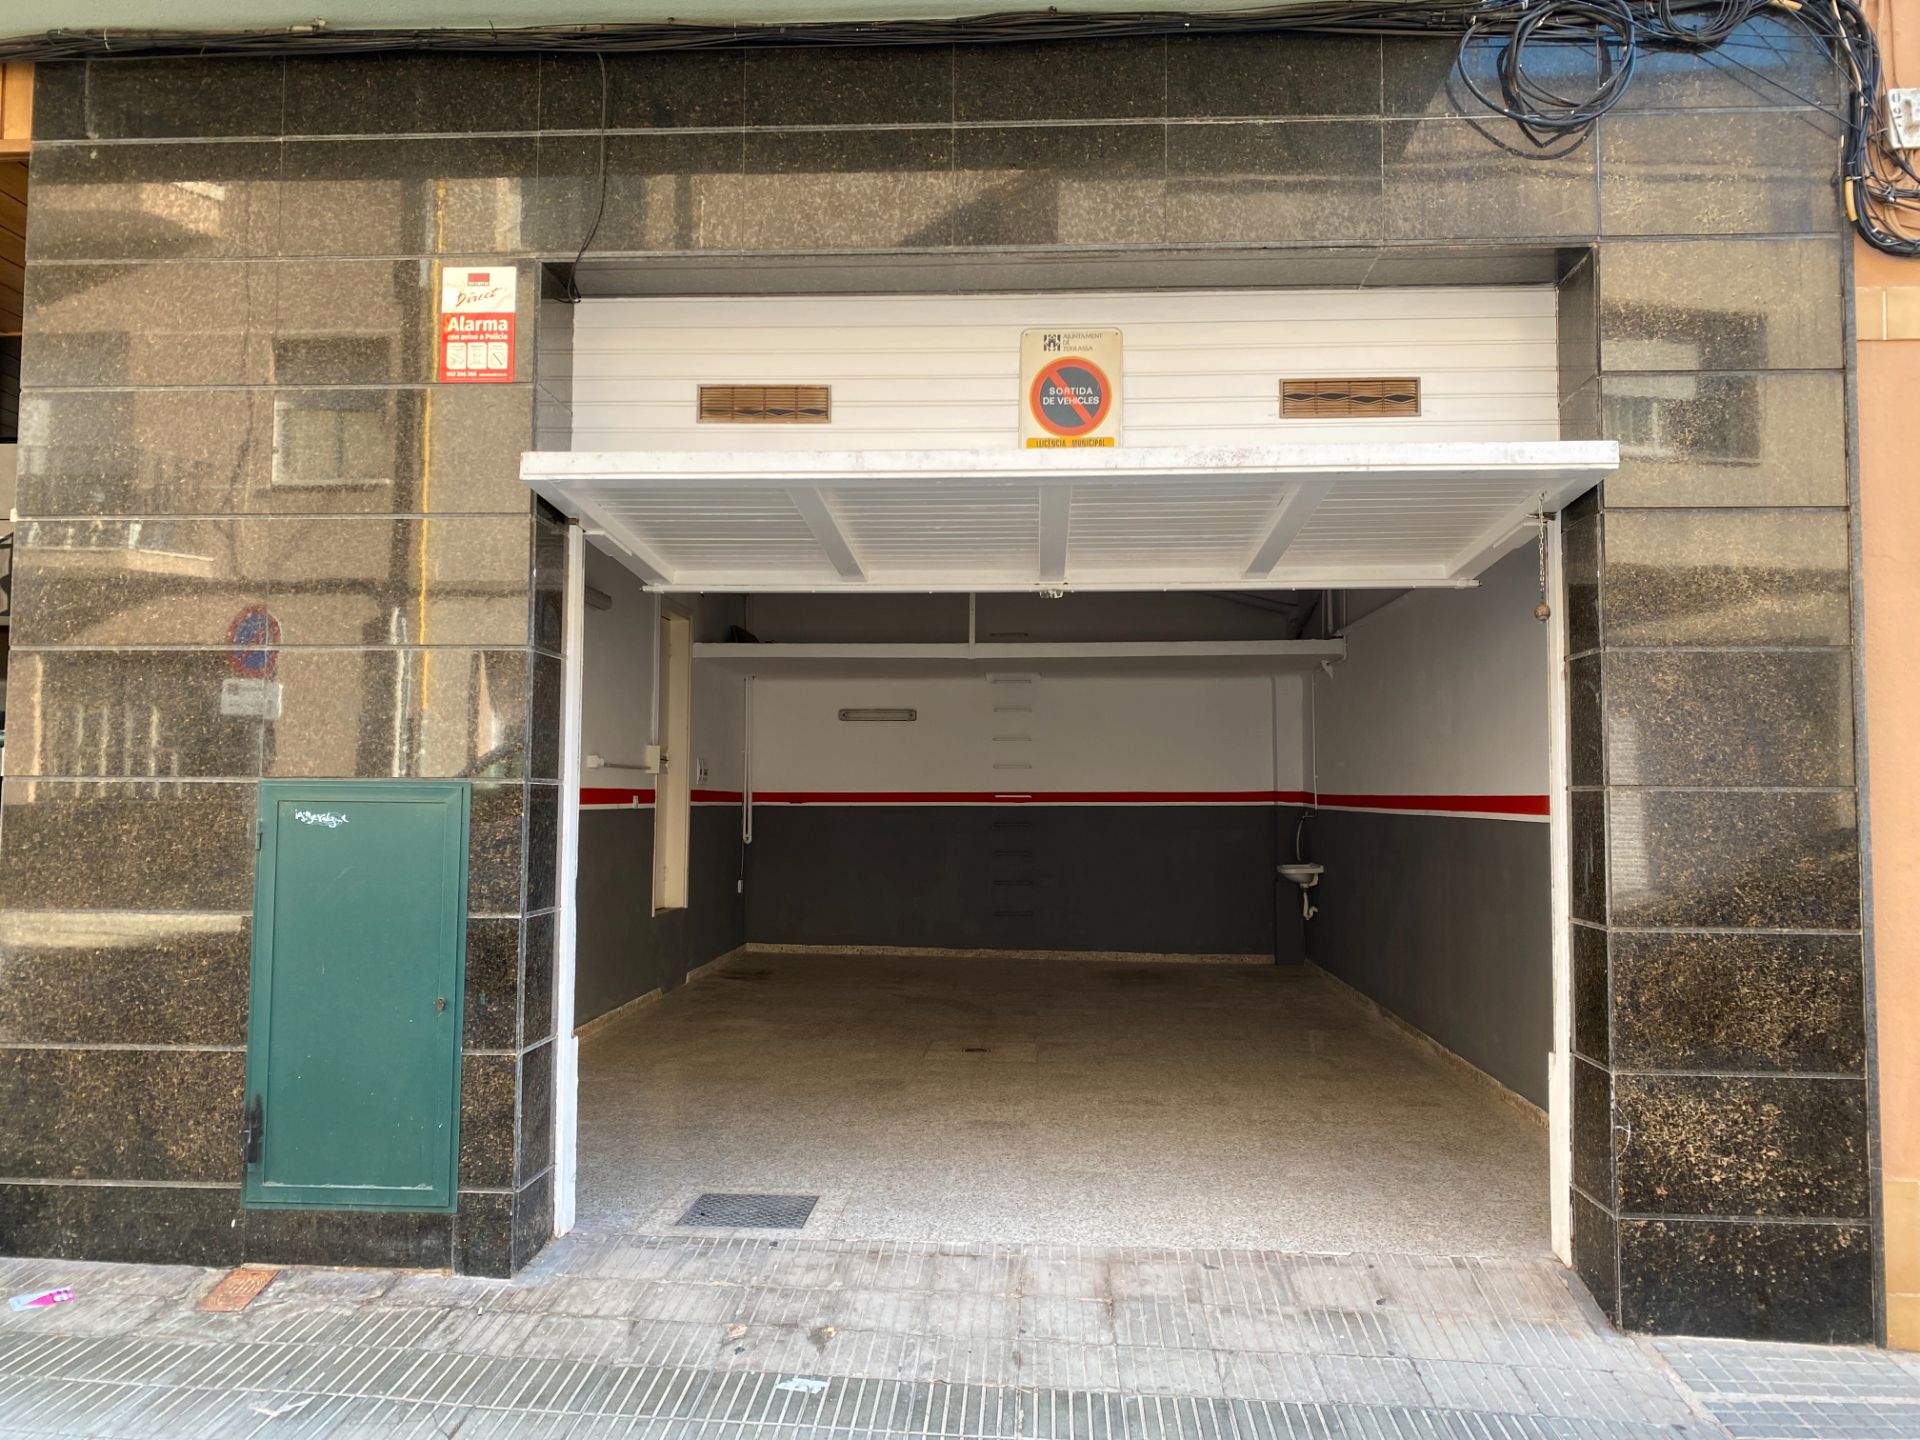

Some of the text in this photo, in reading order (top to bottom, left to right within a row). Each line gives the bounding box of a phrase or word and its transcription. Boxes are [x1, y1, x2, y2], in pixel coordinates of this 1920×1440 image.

[455, 287, 503, 308] Direct
[448, 316, 508, 332] Alarma
[1049, 387, 1093, 395] SORTIDA
[1043, 396, 1099, 405] DE VEHICLES
[1072, 438, 1105, 447] MUNICIPAL
